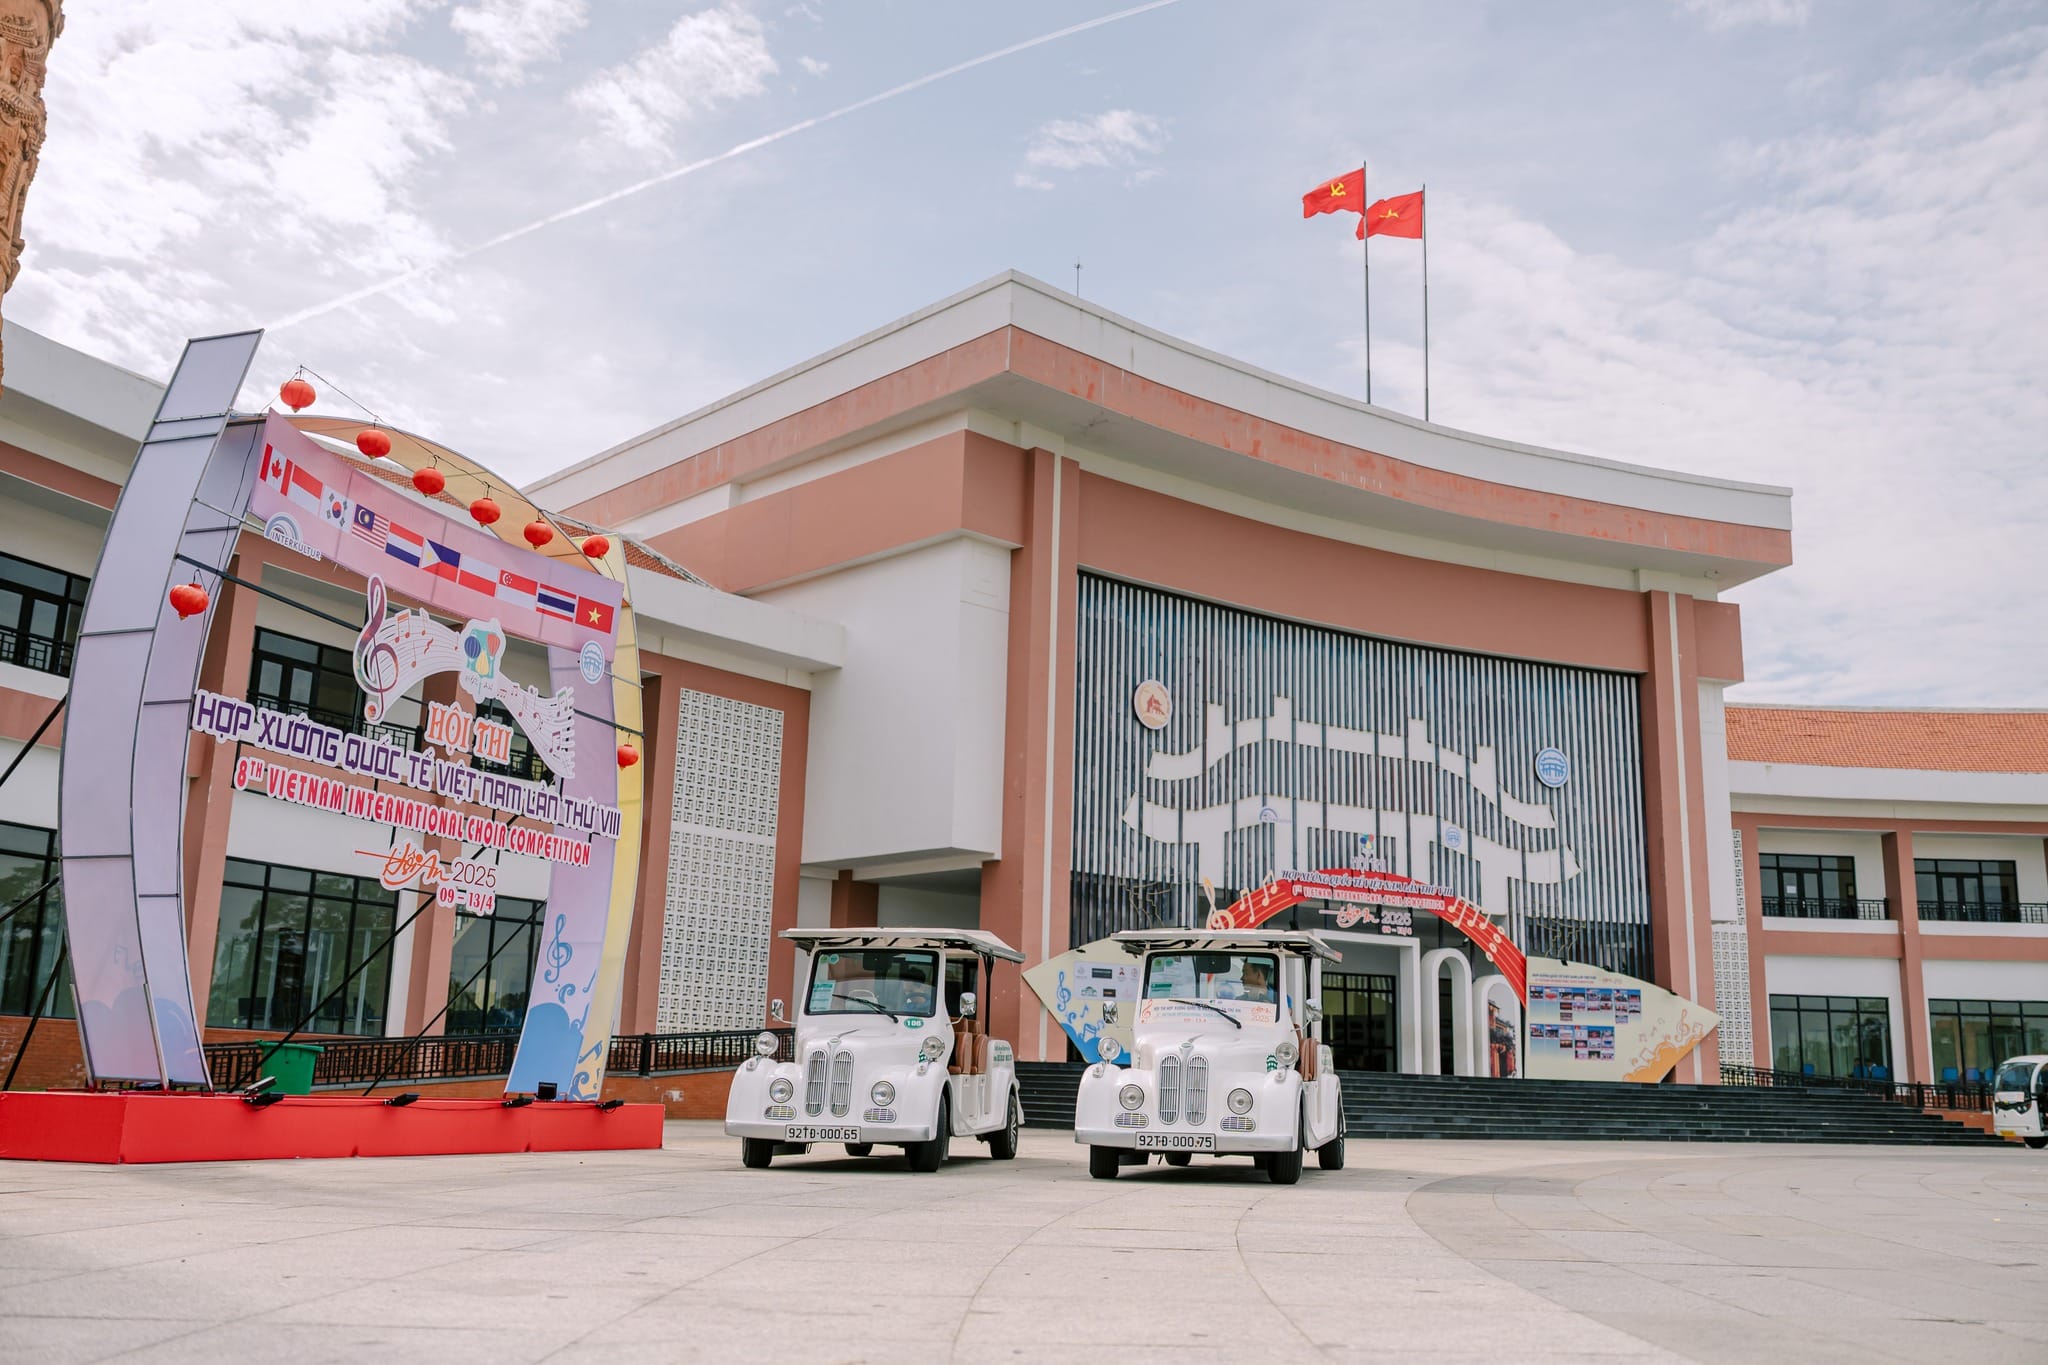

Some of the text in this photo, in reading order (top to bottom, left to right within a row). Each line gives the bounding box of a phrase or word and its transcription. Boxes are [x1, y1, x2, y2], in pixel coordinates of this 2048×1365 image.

[271, 532, 321, 560] INTERKULTUR
[428, 705, 512, 761] HỘI THI
[197, 695, 621, 836] HỢP XƯỚNG QUỐC TẾ VIỆT NAM LẦN THỨ VIII
[237, 760, 591, 865] 8TH VIETNAM INTERNATIONAL CHOIR COMPETITION
[421, 854, 449, 881] An
[453, 861, 496, 888] 2025
[440, 887, 454, 903] 09
[469, 892, 493, 911] 13/4
[1381, 911, 1412, 926] 2025
